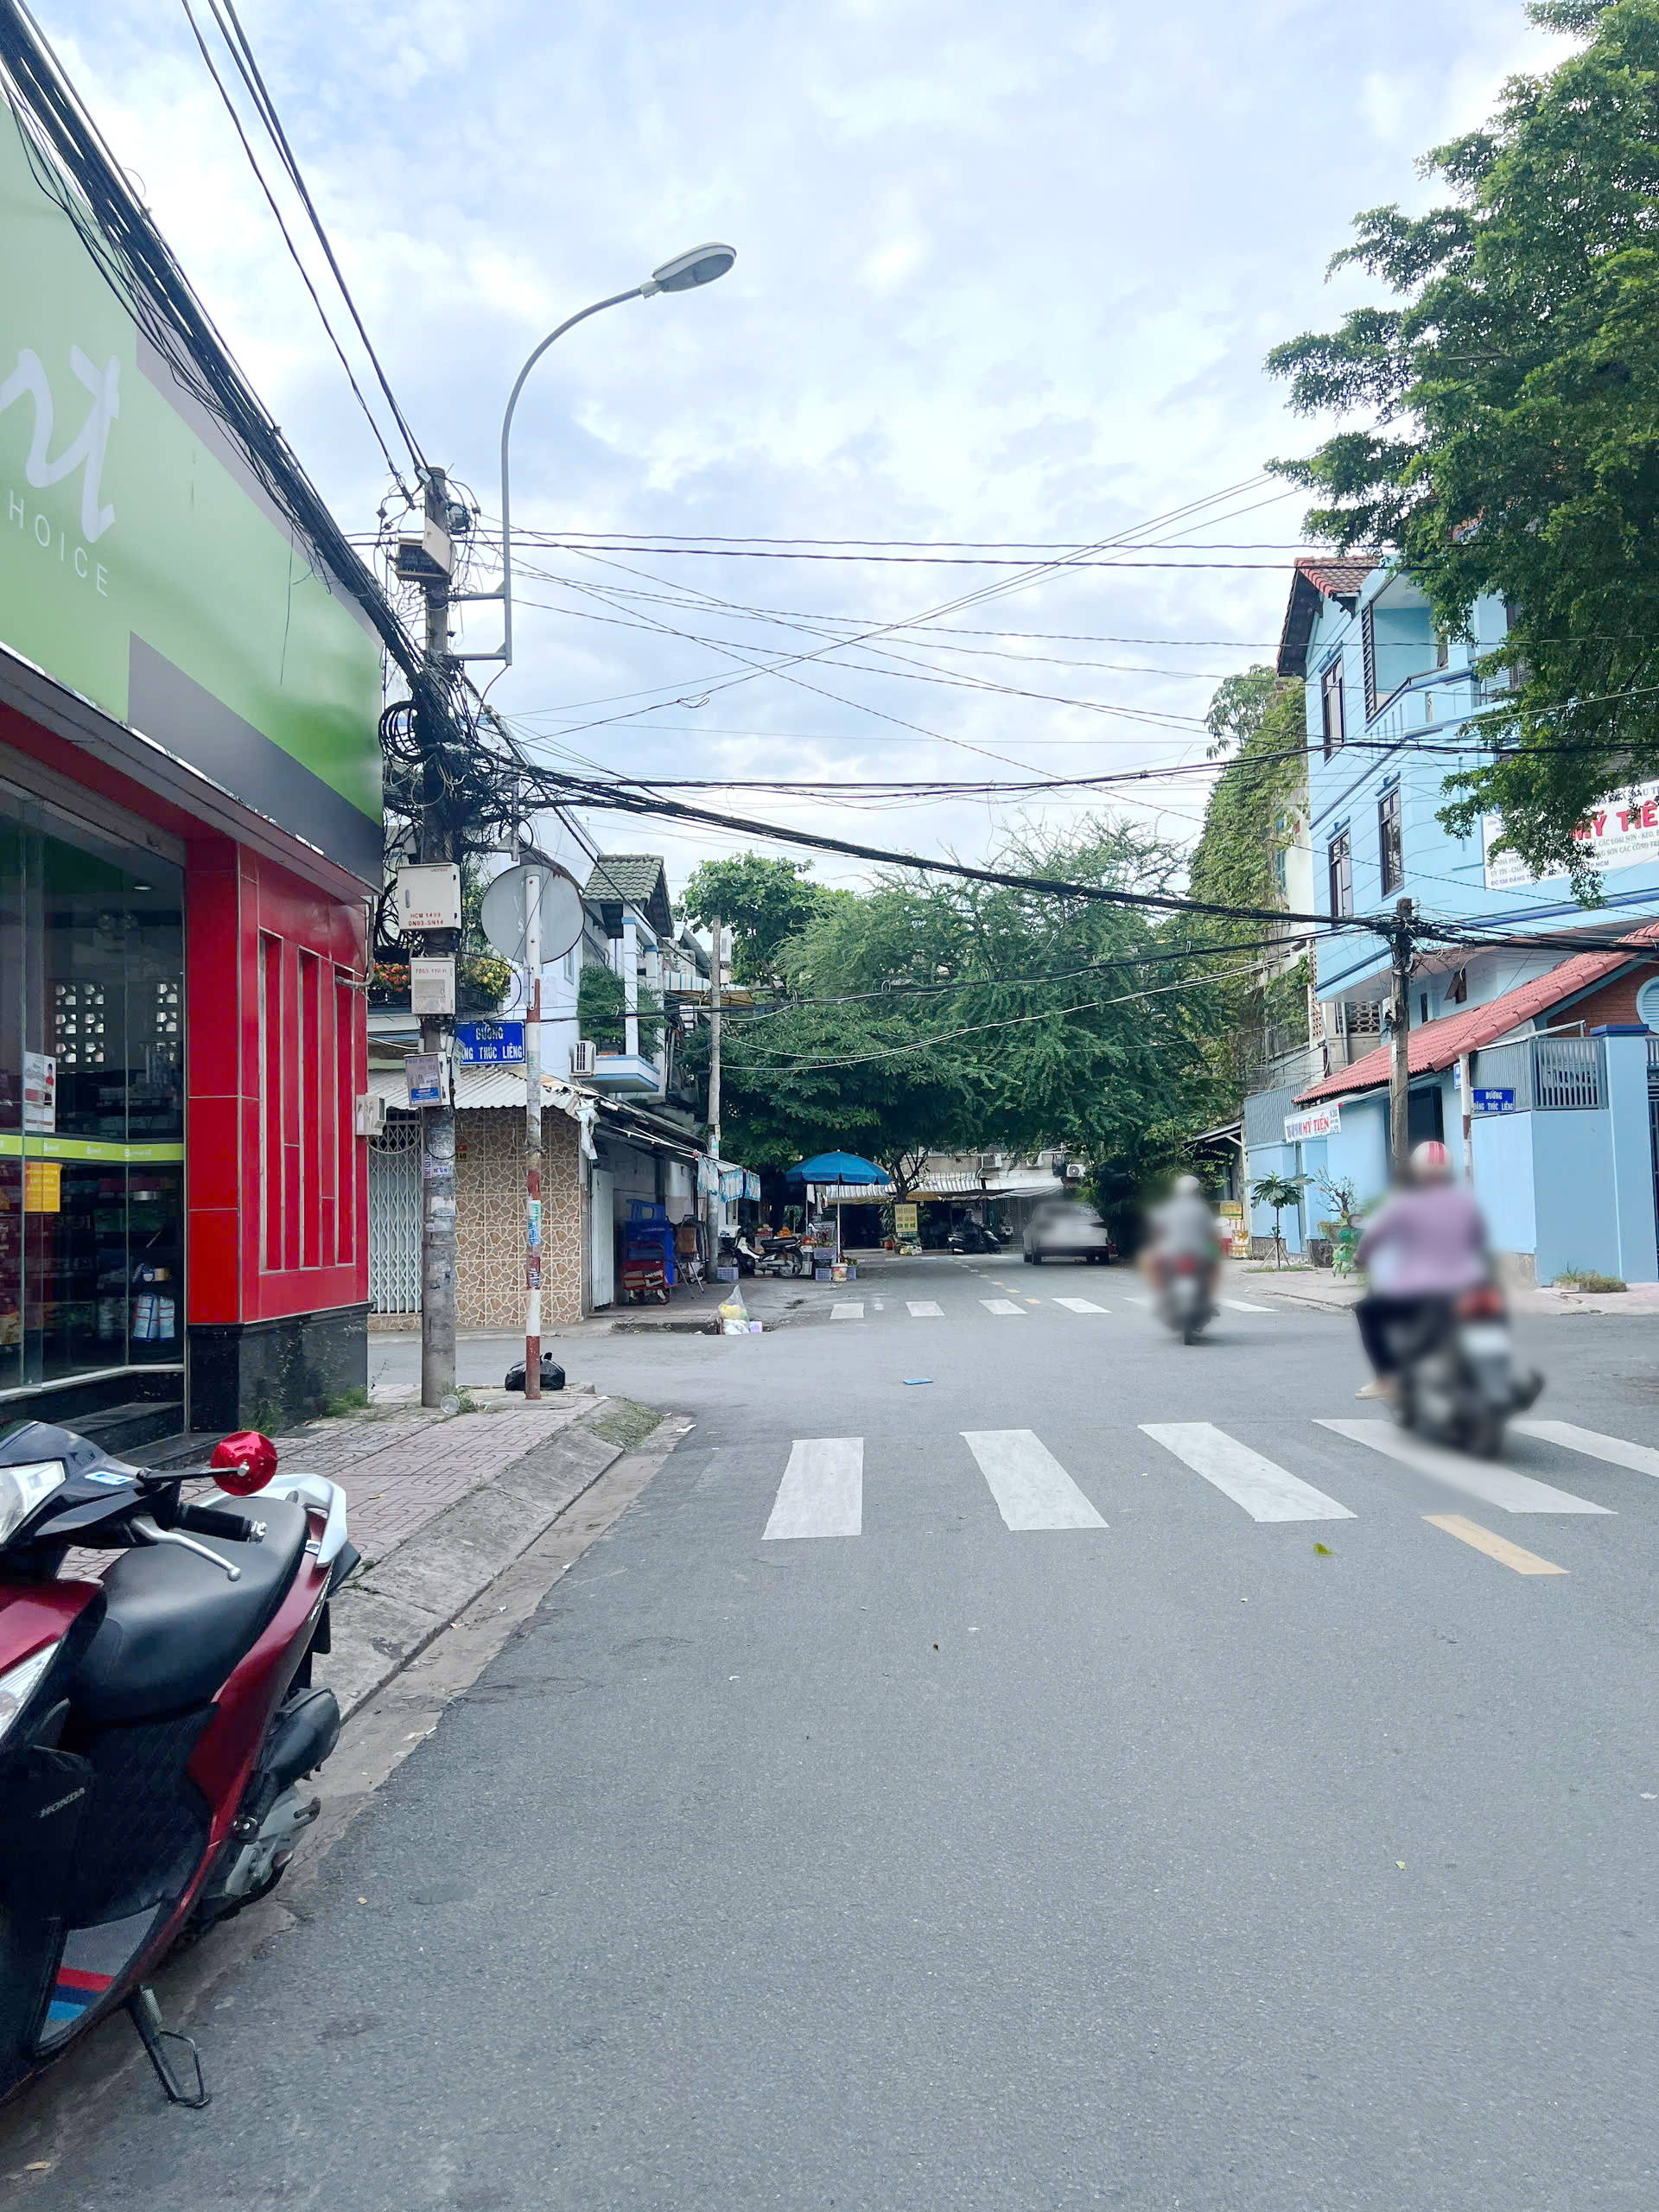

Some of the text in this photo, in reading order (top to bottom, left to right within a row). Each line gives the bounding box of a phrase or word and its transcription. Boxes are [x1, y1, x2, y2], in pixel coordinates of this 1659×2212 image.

[480, 1042, 498, 1060] THÚC
[502, 1042, 523, 1059] LIÊNG
[40, 1787, 86, 1818] HONDA
